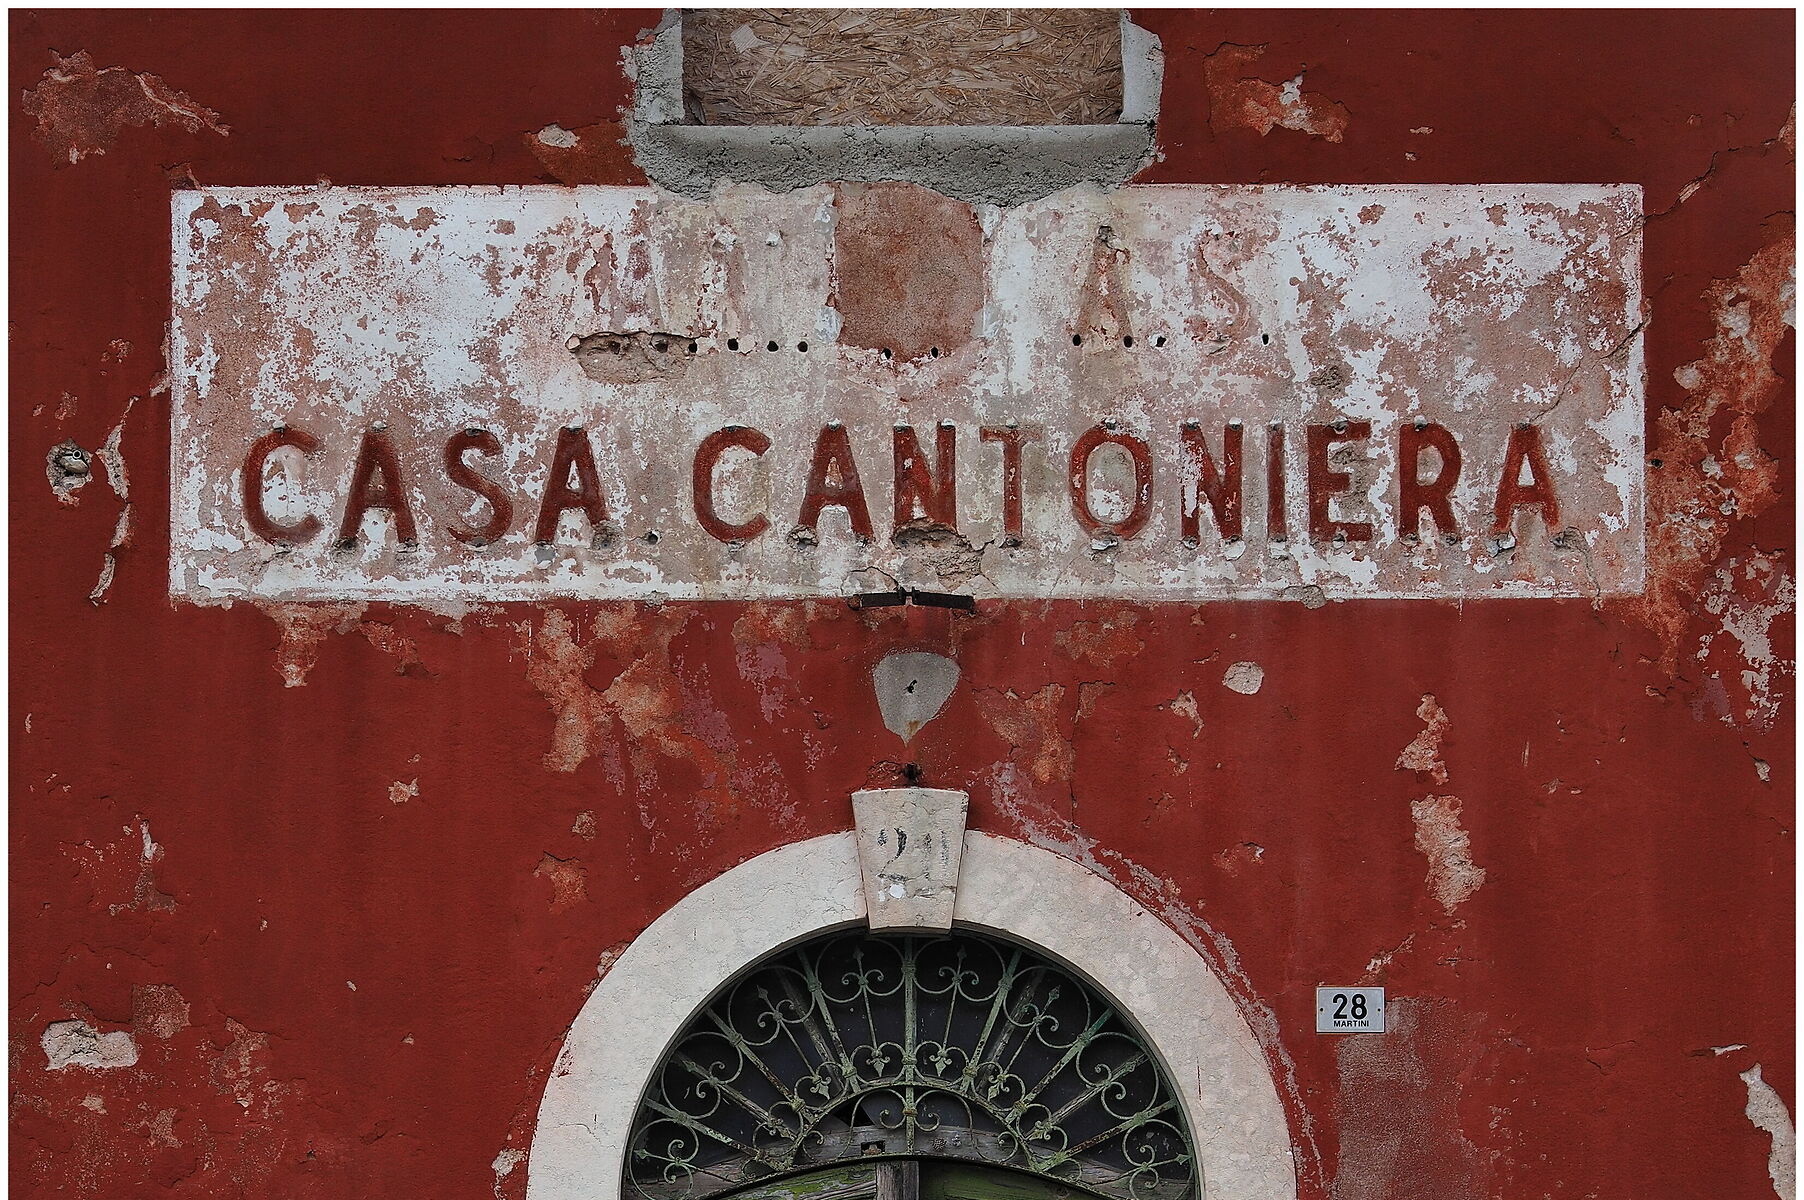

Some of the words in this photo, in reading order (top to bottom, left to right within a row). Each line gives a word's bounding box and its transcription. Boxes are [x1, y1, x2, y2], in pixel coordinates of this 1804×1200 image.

[241, 425, 610, 547] CASA
[692, 420, 1563, 547] CANTONIERA
[1332, 993, 1368, 1020] 28
[1333, 1020, 1370, 1028] MARTINI
